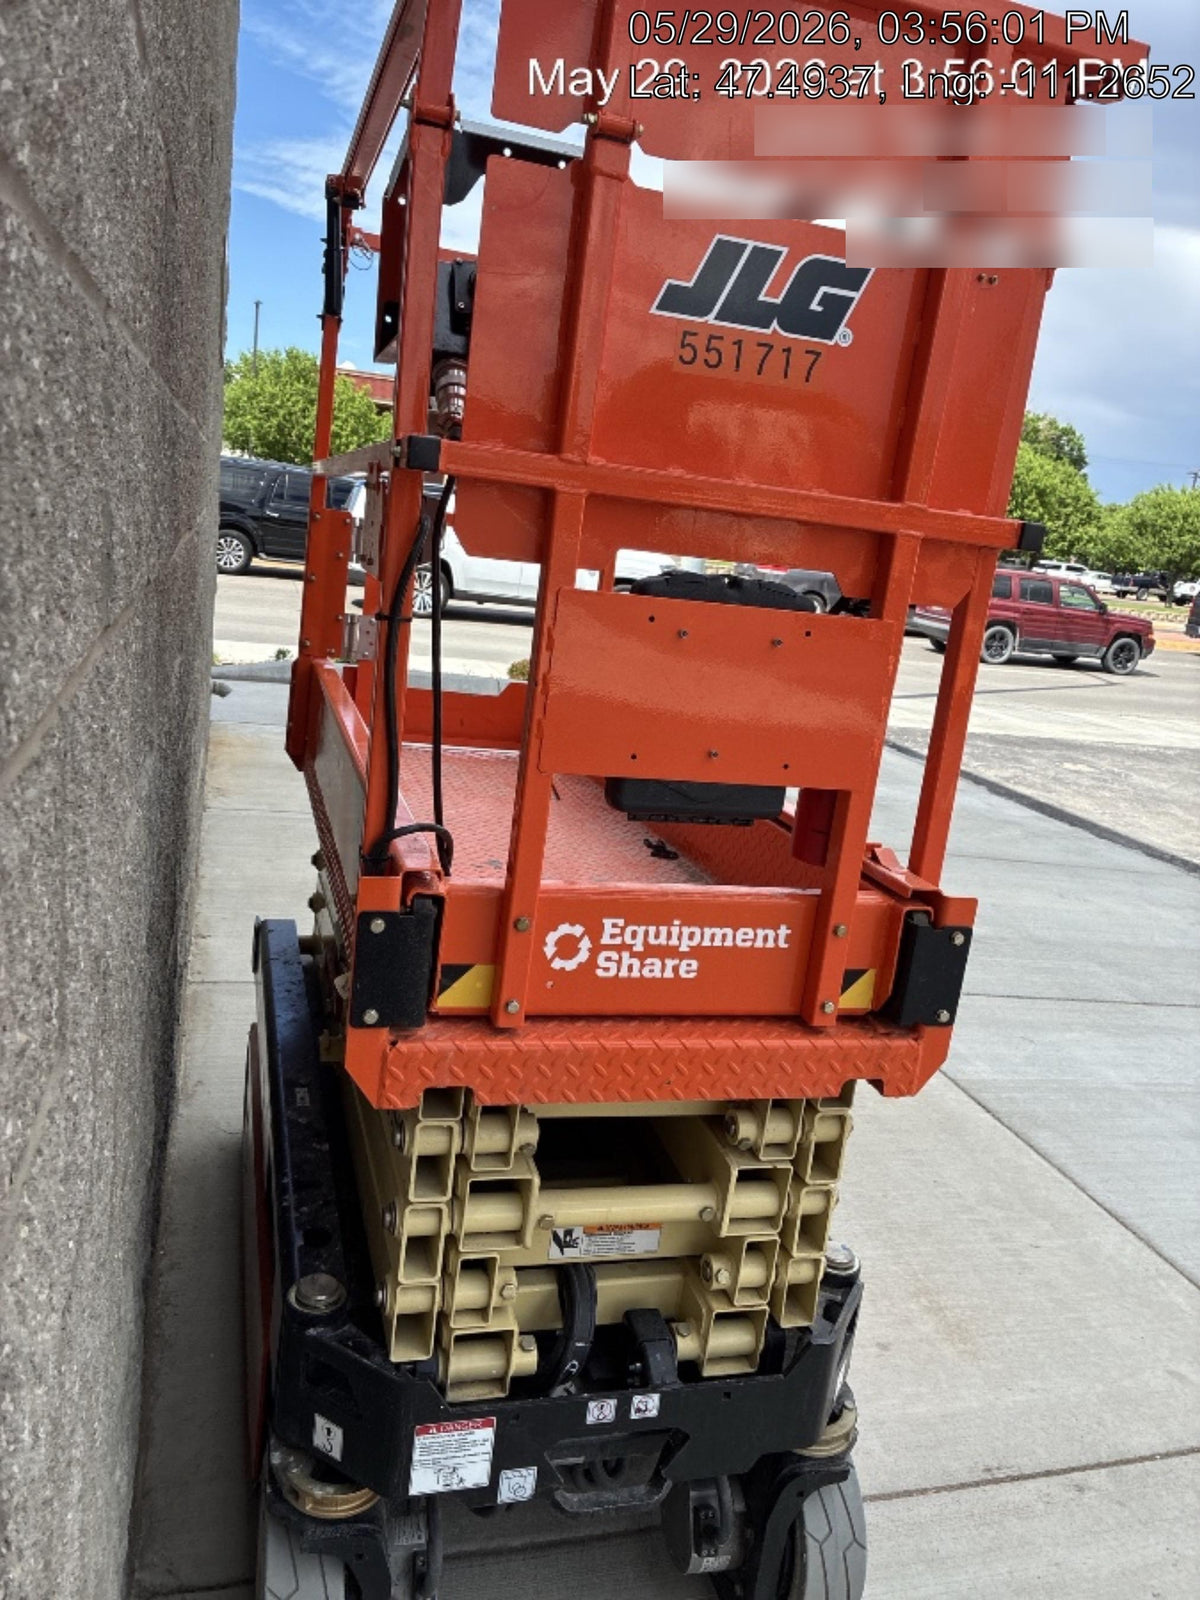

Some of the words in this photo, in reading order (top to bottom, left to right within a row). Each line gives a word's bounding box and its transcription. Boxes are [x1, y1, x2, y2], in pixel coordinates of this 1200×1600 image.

[649, 233, 876, 345] JLG
[678, 330, 822, 383] 551717
[600, 917, 792, 951] Equipment
[595, 951, 698, 979] Share
